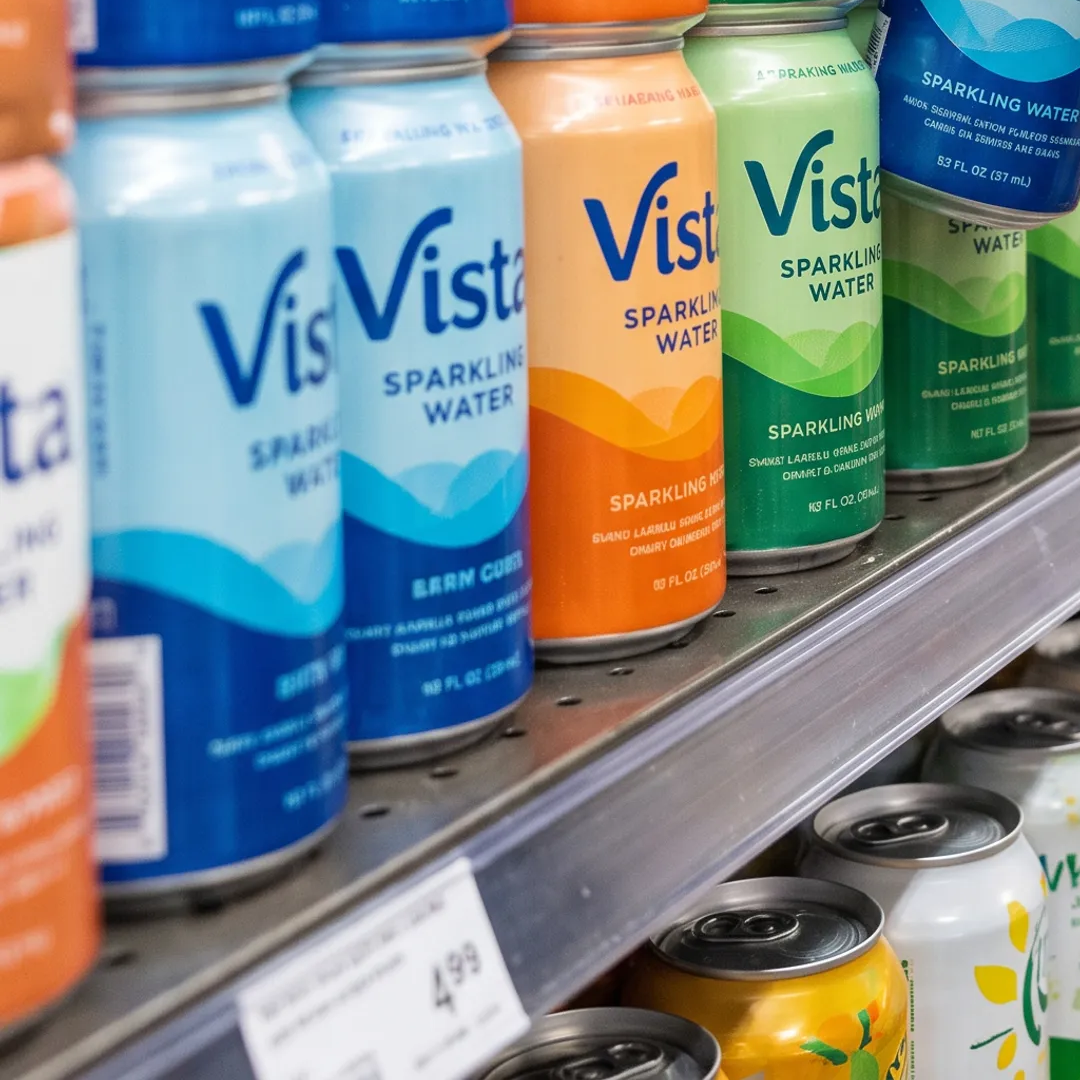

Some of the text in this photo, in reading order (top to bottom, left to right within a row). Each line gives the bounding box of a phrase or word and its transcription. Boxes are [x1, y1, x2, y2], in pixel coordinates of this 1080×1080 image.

[921, 70, 1080, 124] SPARKLING WATER
[971, 165, 988, 179] OZ
[583, 161, 720, 282] Vist
[780, 242, 881, 280] SPARKLING
[809, 271, 875, 303] WATER
[196, 244, 337, 408] Vis
[624, 287, 720, 330] SPARKLIN
[655, 318, 718, 355] WATER
[937, 350, 1016, 375] SPARKLING
[423, 383, 514, 426] WATER
[767, 410, 863, 440] SPARKLING
[609, 474, 706, 513] SPARKLING
[824, 498, 838, 510] FL
[668, 575, 684, 589] FL
